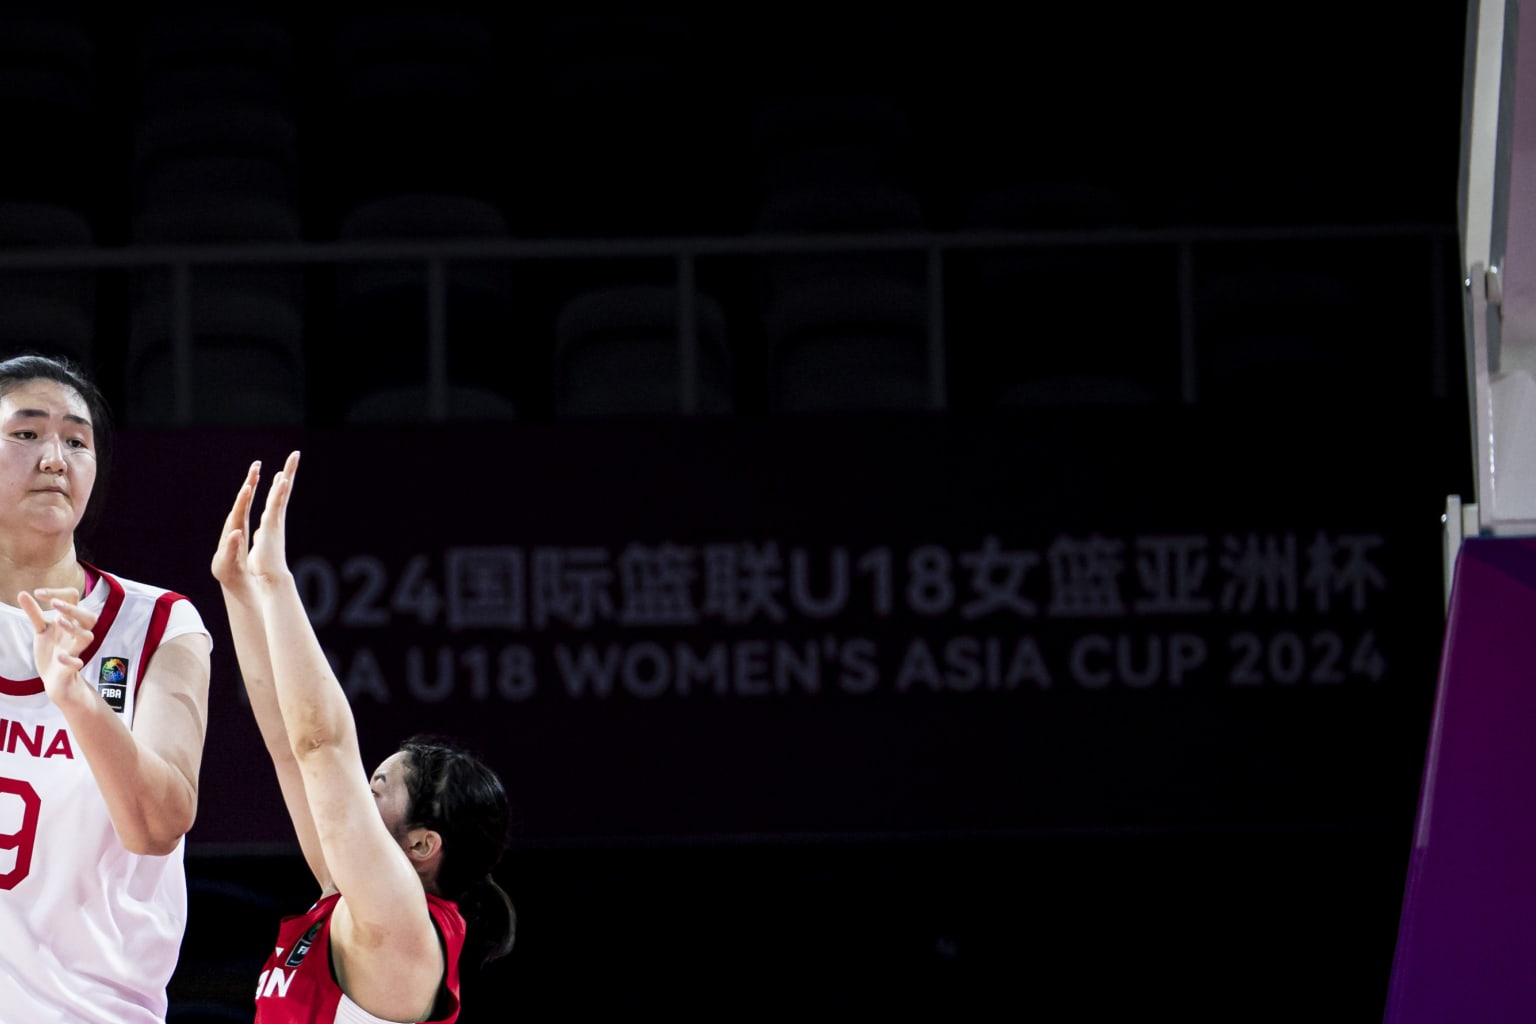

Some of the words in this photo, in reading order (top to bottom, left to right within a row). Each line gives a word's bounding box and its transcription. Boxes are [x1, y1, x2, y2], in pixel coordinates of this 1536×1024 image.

[404, 642, 538, 701] U18
[552, 632, 880, 699] WOMEN'S
[894, 634, 1054, 692] ASIA
[1066, 631, 1210, 689] CUP
[1222, 629, 1388, 687] 2024
[101, 688, 122, 699] FIBA
